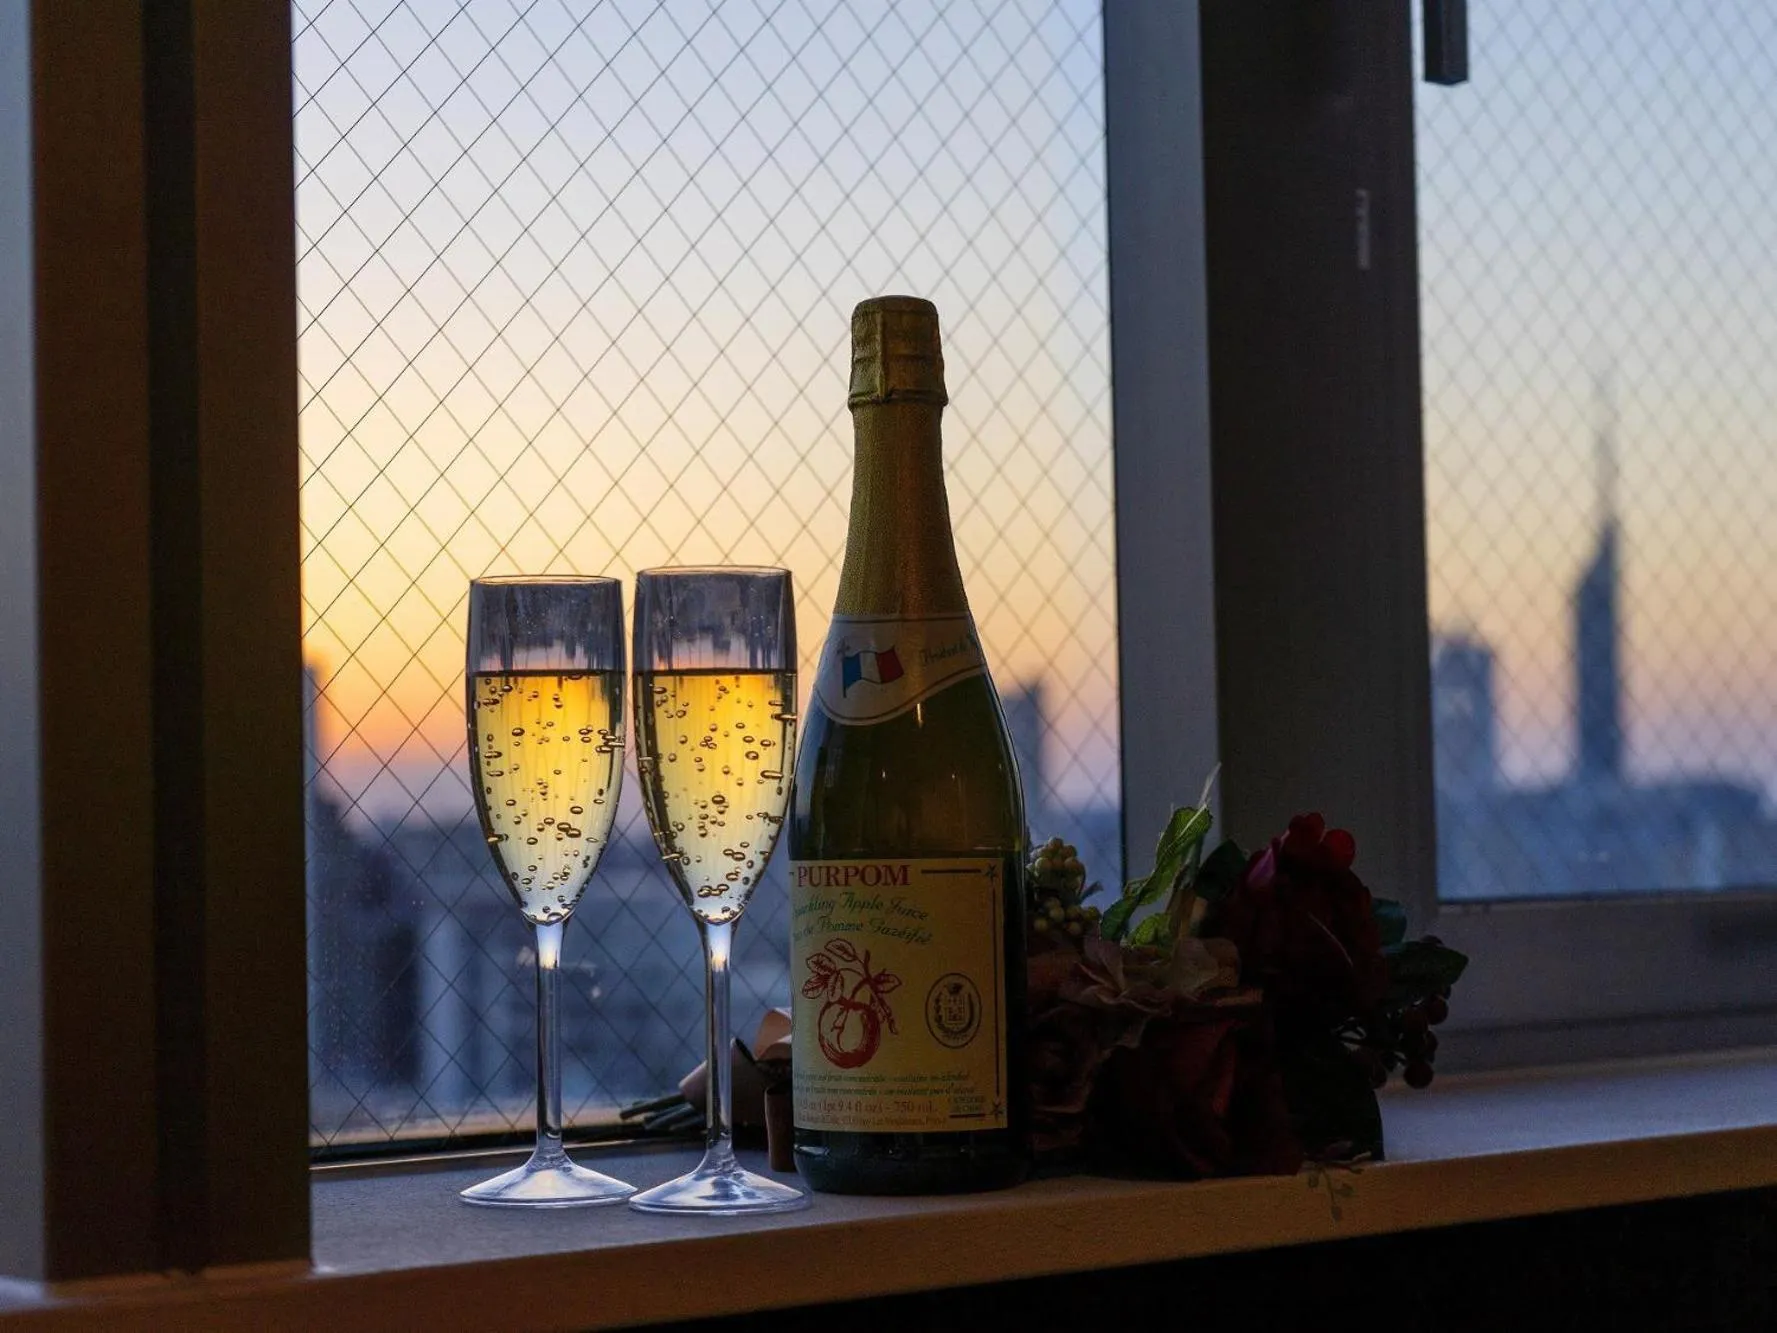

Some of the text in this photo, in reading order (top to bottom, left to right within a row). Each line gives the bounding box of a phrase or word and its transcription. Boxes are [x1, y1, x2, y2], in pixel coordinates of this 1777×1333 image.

[797, 864, 912, 888] PURPOM
[840, 892, 883, 913] Apple
[884, 896, 929, 921] Juice
[818, 915, 863, 932] Pomme
